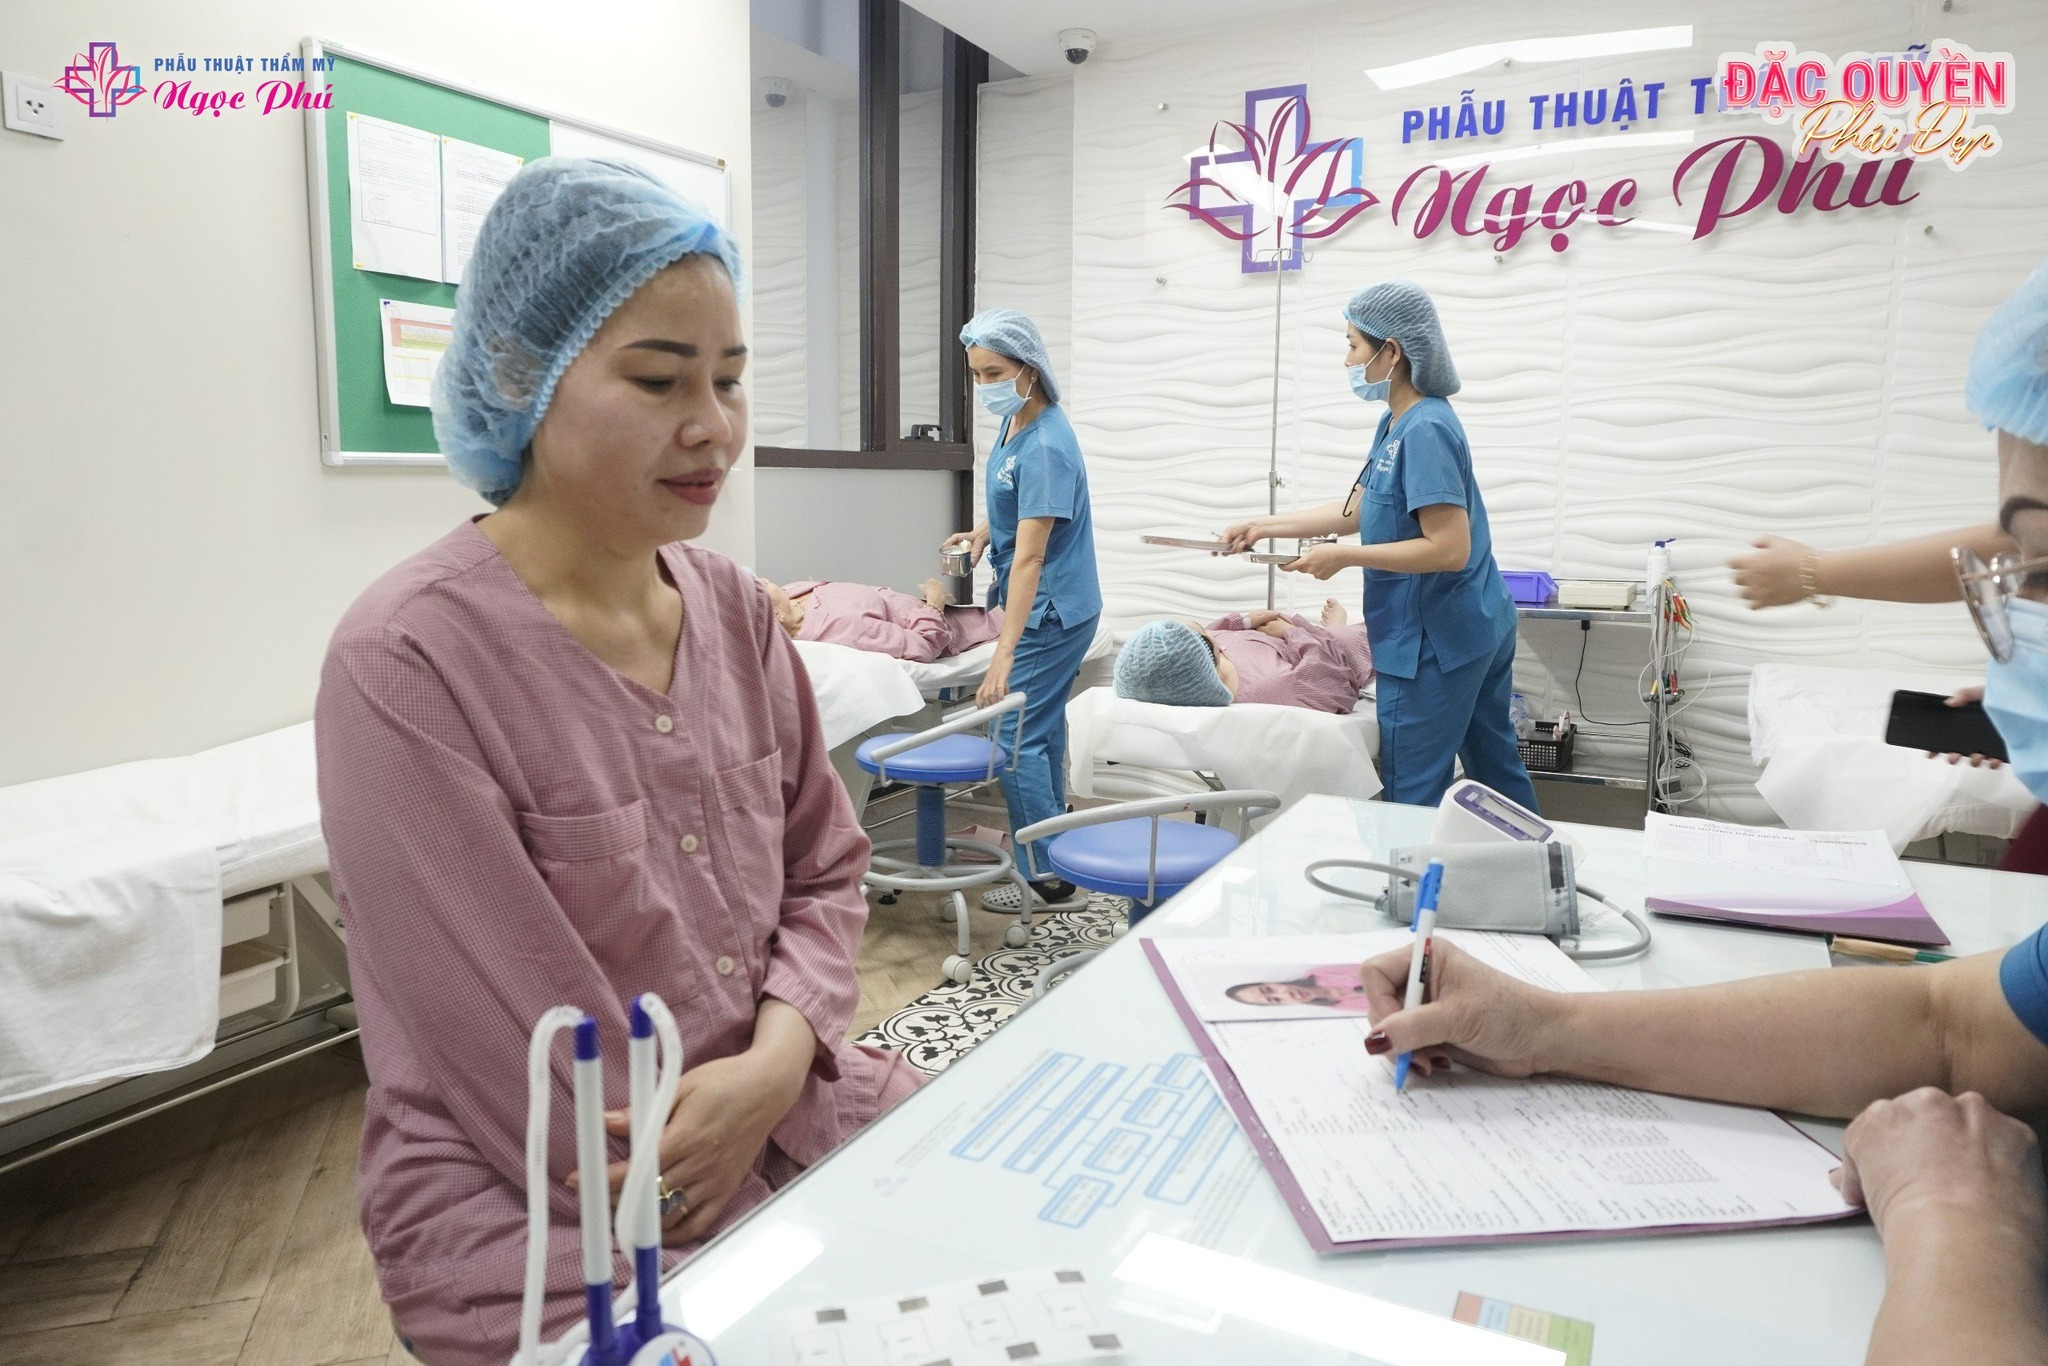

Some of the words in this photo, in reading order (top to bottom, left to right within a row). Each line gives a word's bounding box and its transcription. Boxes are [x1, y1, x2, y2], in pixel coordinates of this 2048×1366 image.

[1402, 88, 1505, 144] PHẪU
[1529, 78, 1665, 131] THUẬT
[1391, 161, 1641, 253] Ngọc
